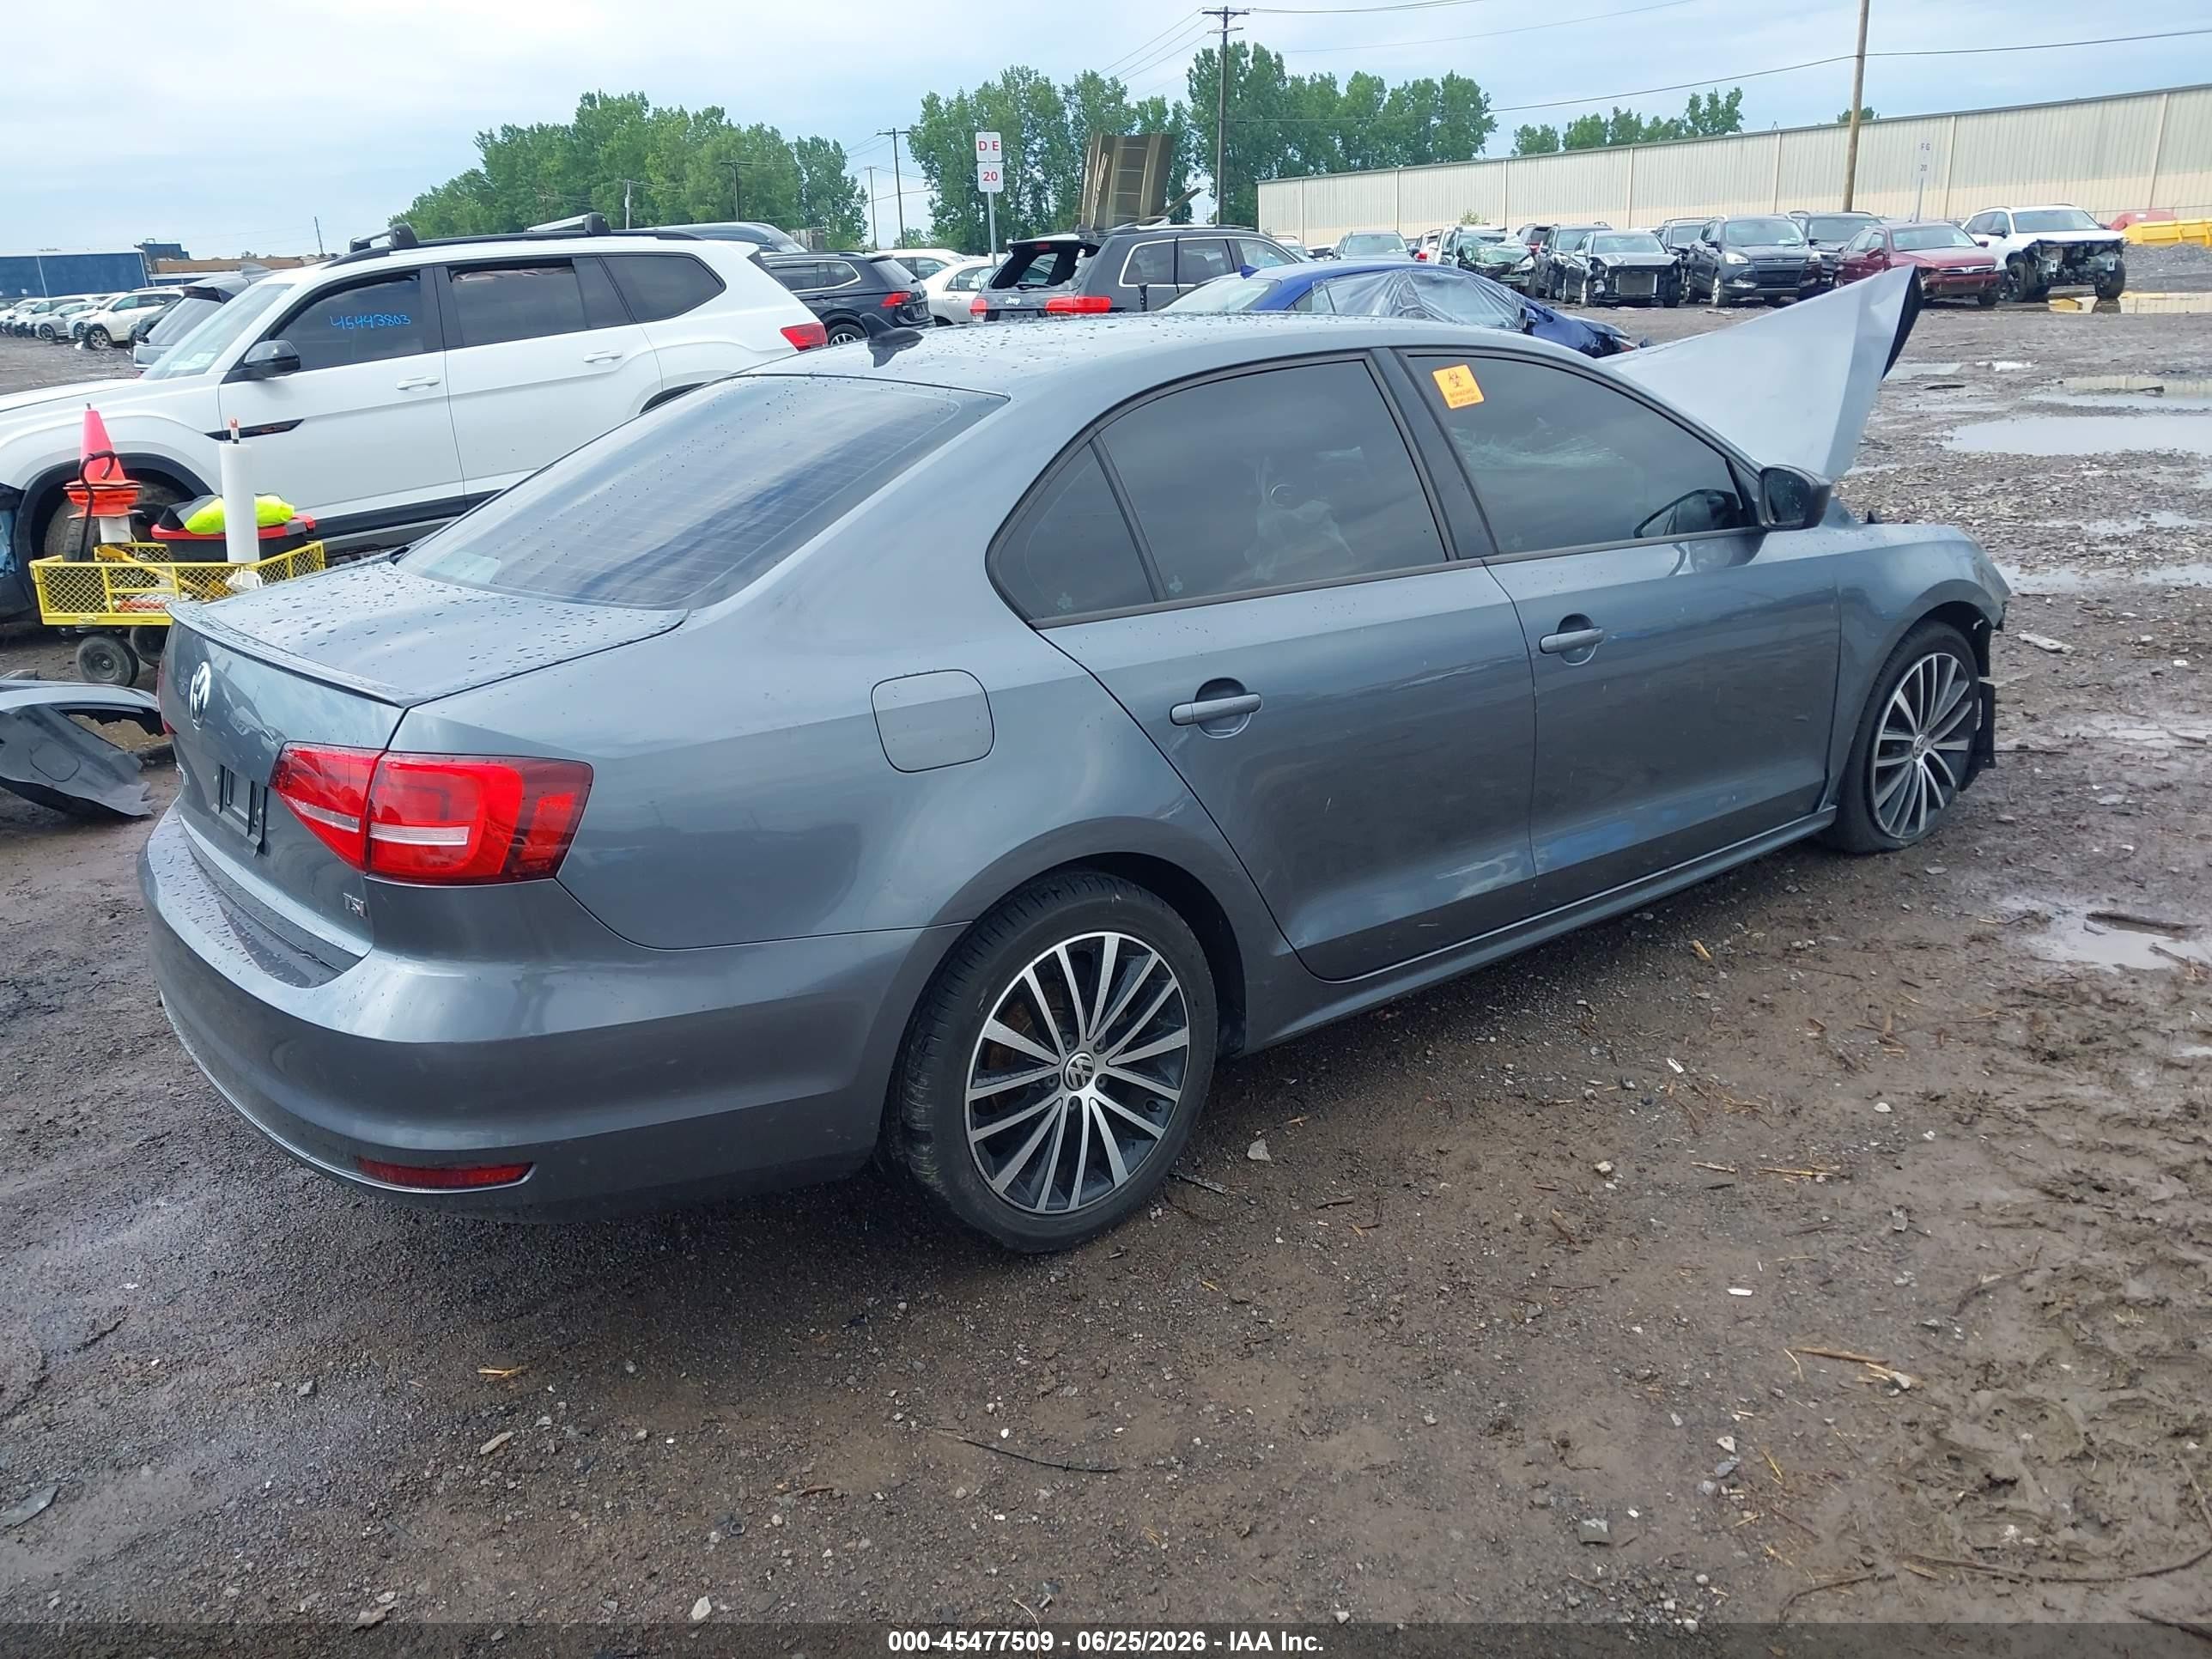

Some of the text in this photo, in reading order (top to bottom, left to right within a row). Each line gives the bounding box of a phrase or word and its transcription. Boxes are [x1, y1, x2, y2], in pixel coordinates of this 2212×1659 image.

[982, 171, 999, 182] 20
[1005, 295, 1021, 306] Jeep
[329, 314, 411, 330] 45443803
